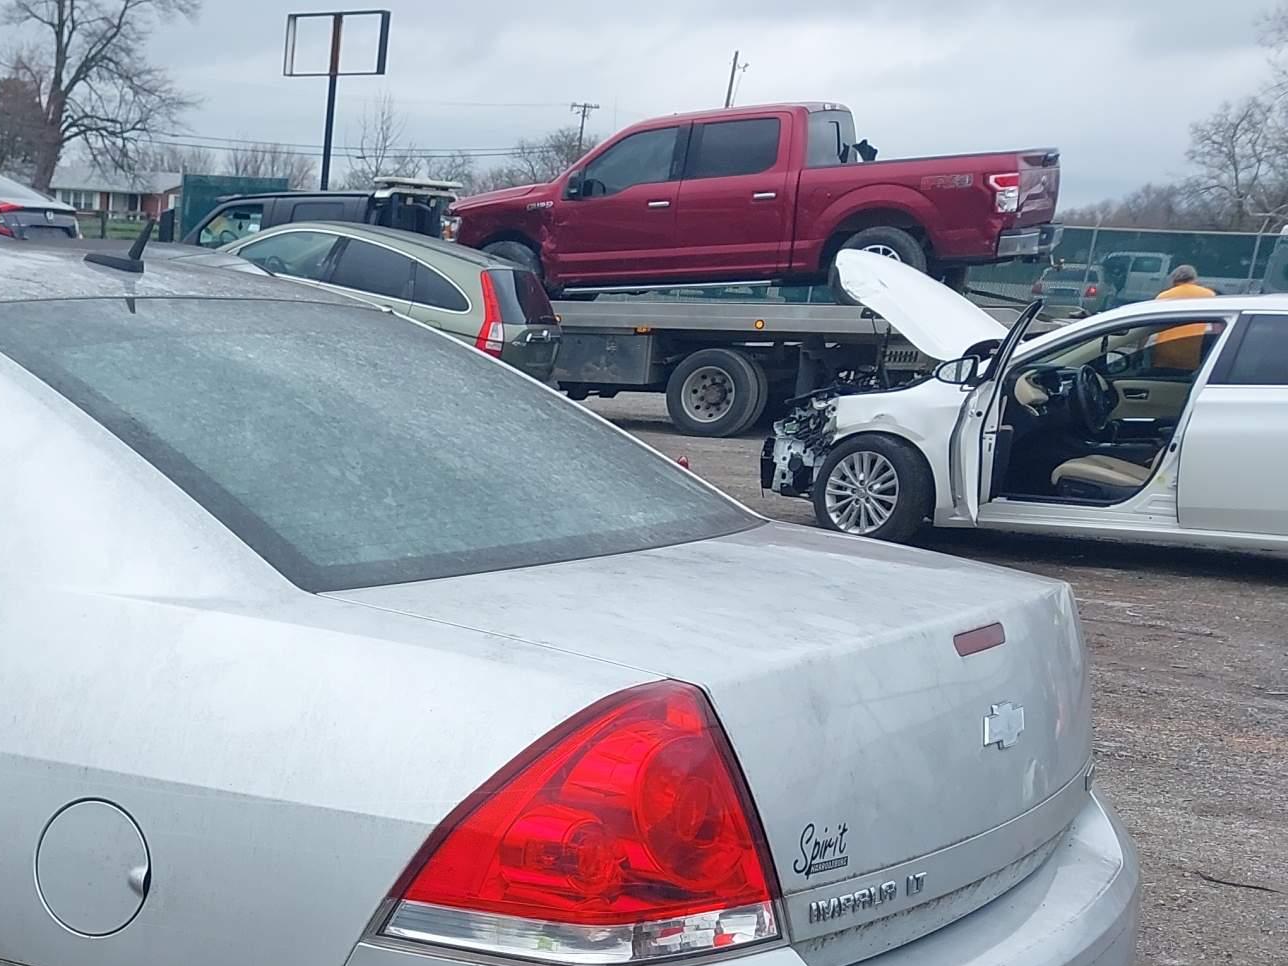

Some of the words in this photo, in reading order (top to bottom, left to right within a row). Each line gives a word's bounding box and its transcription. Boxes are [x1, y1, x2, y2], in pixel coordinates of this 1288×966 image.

[793, 822, 848, 880] Spirit
[809, 881, 898, 924] IMPALA
[905, 872, 928, 897] LT
